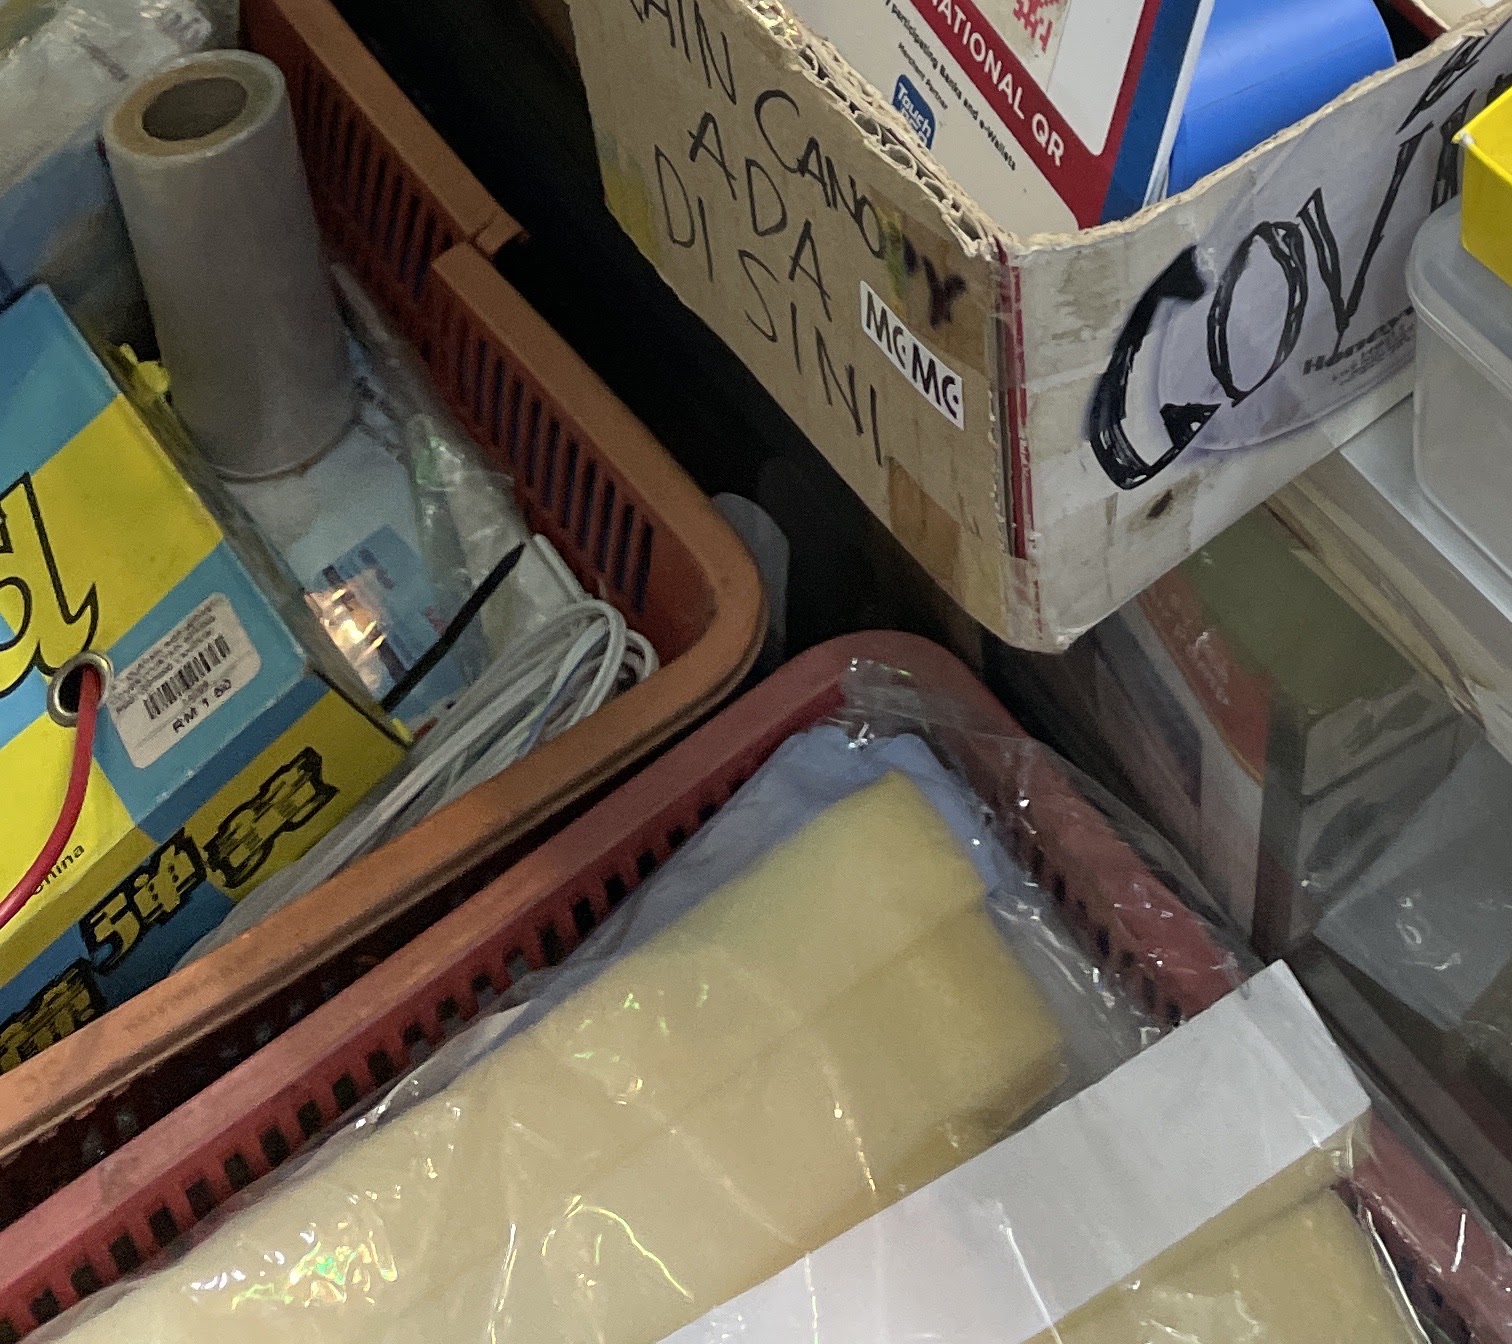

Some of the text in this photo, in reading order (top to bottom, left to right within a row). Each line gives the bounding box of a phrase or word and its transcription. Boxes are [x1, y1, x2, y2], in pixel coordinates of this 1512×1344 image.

[896, 82, 933, 138] Touch
[1031, 112, 1066, 167] QR
[753, 89, 967, 331] CANOY
[172, 707, 198, 733] RM
